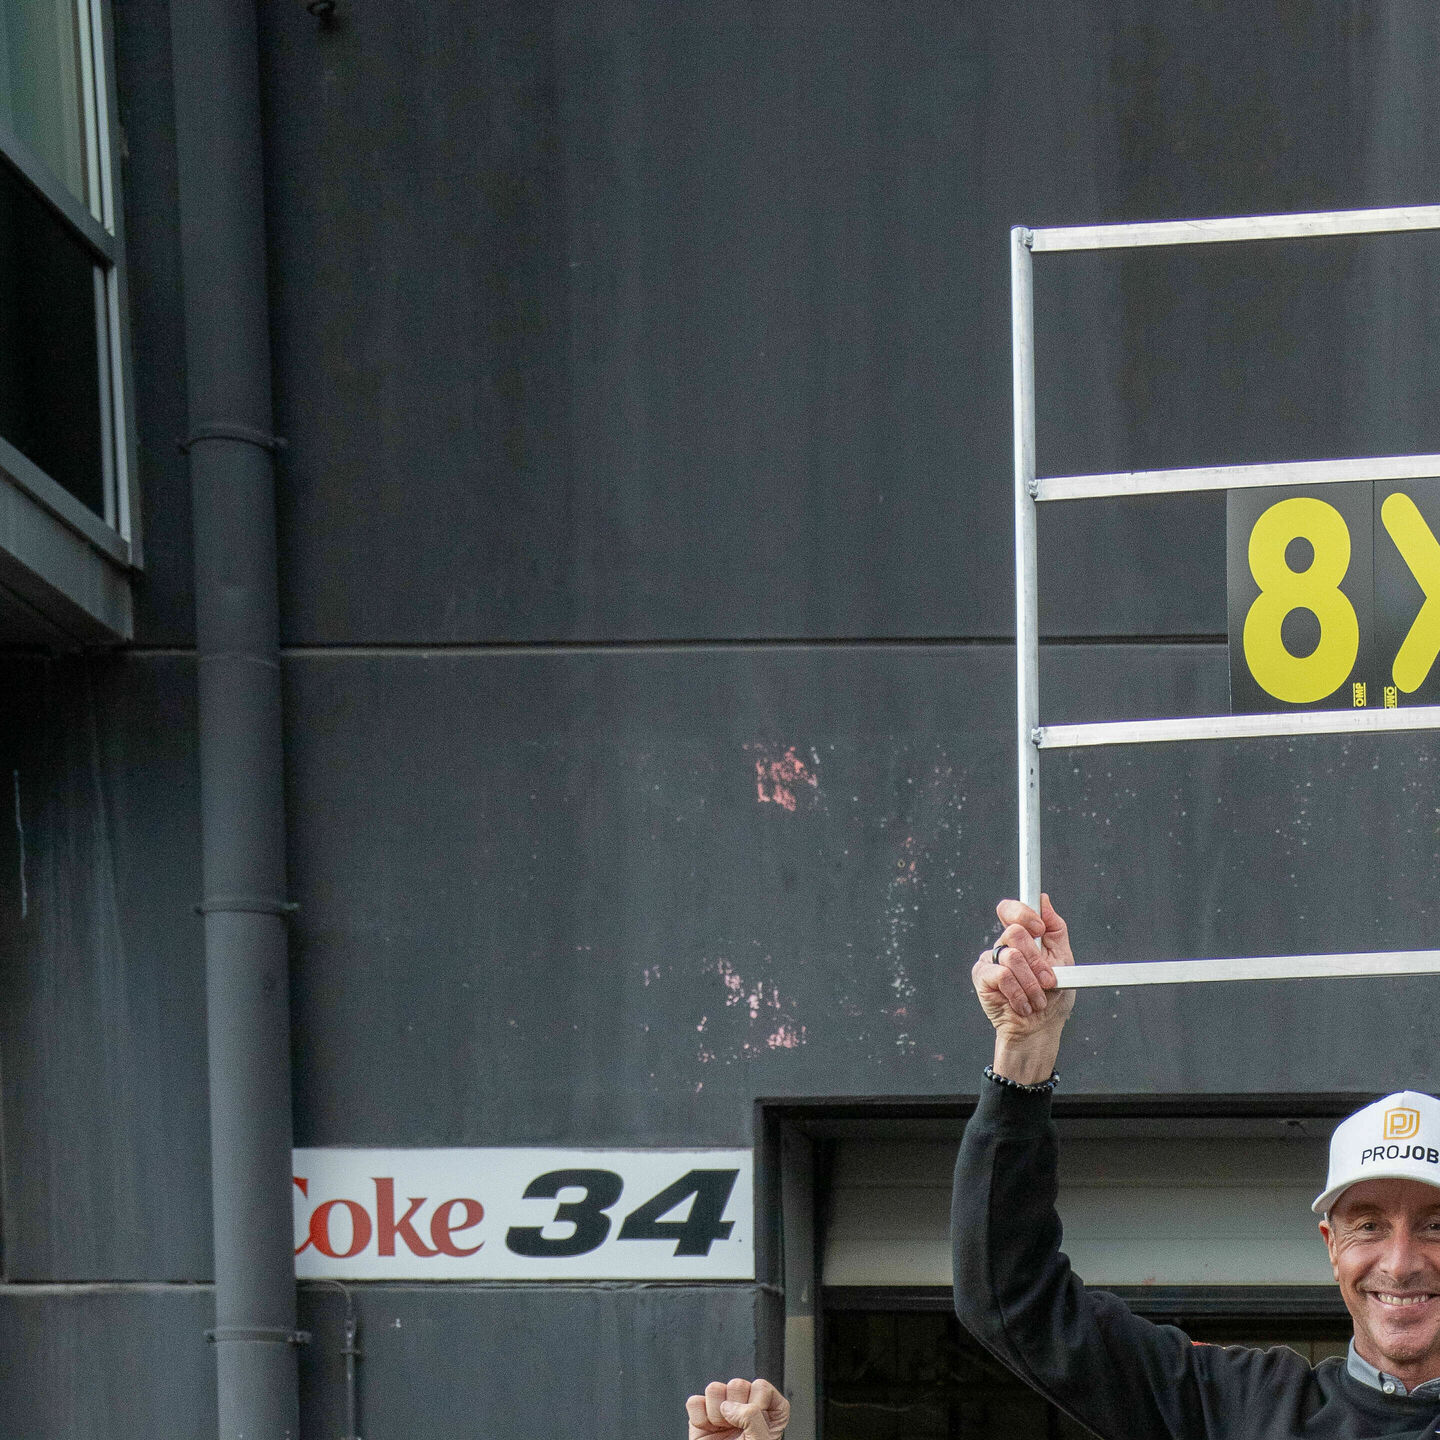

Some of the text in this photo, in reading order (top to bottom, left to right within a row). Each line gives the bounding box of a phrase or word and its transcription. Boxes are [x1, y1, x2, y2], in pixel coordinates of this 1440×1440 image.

[1355, 682, 1365, 708] OMP
[1361, 1144, 1440, 1166] PROJOB
[505, 1168, 741, 1258] 34
